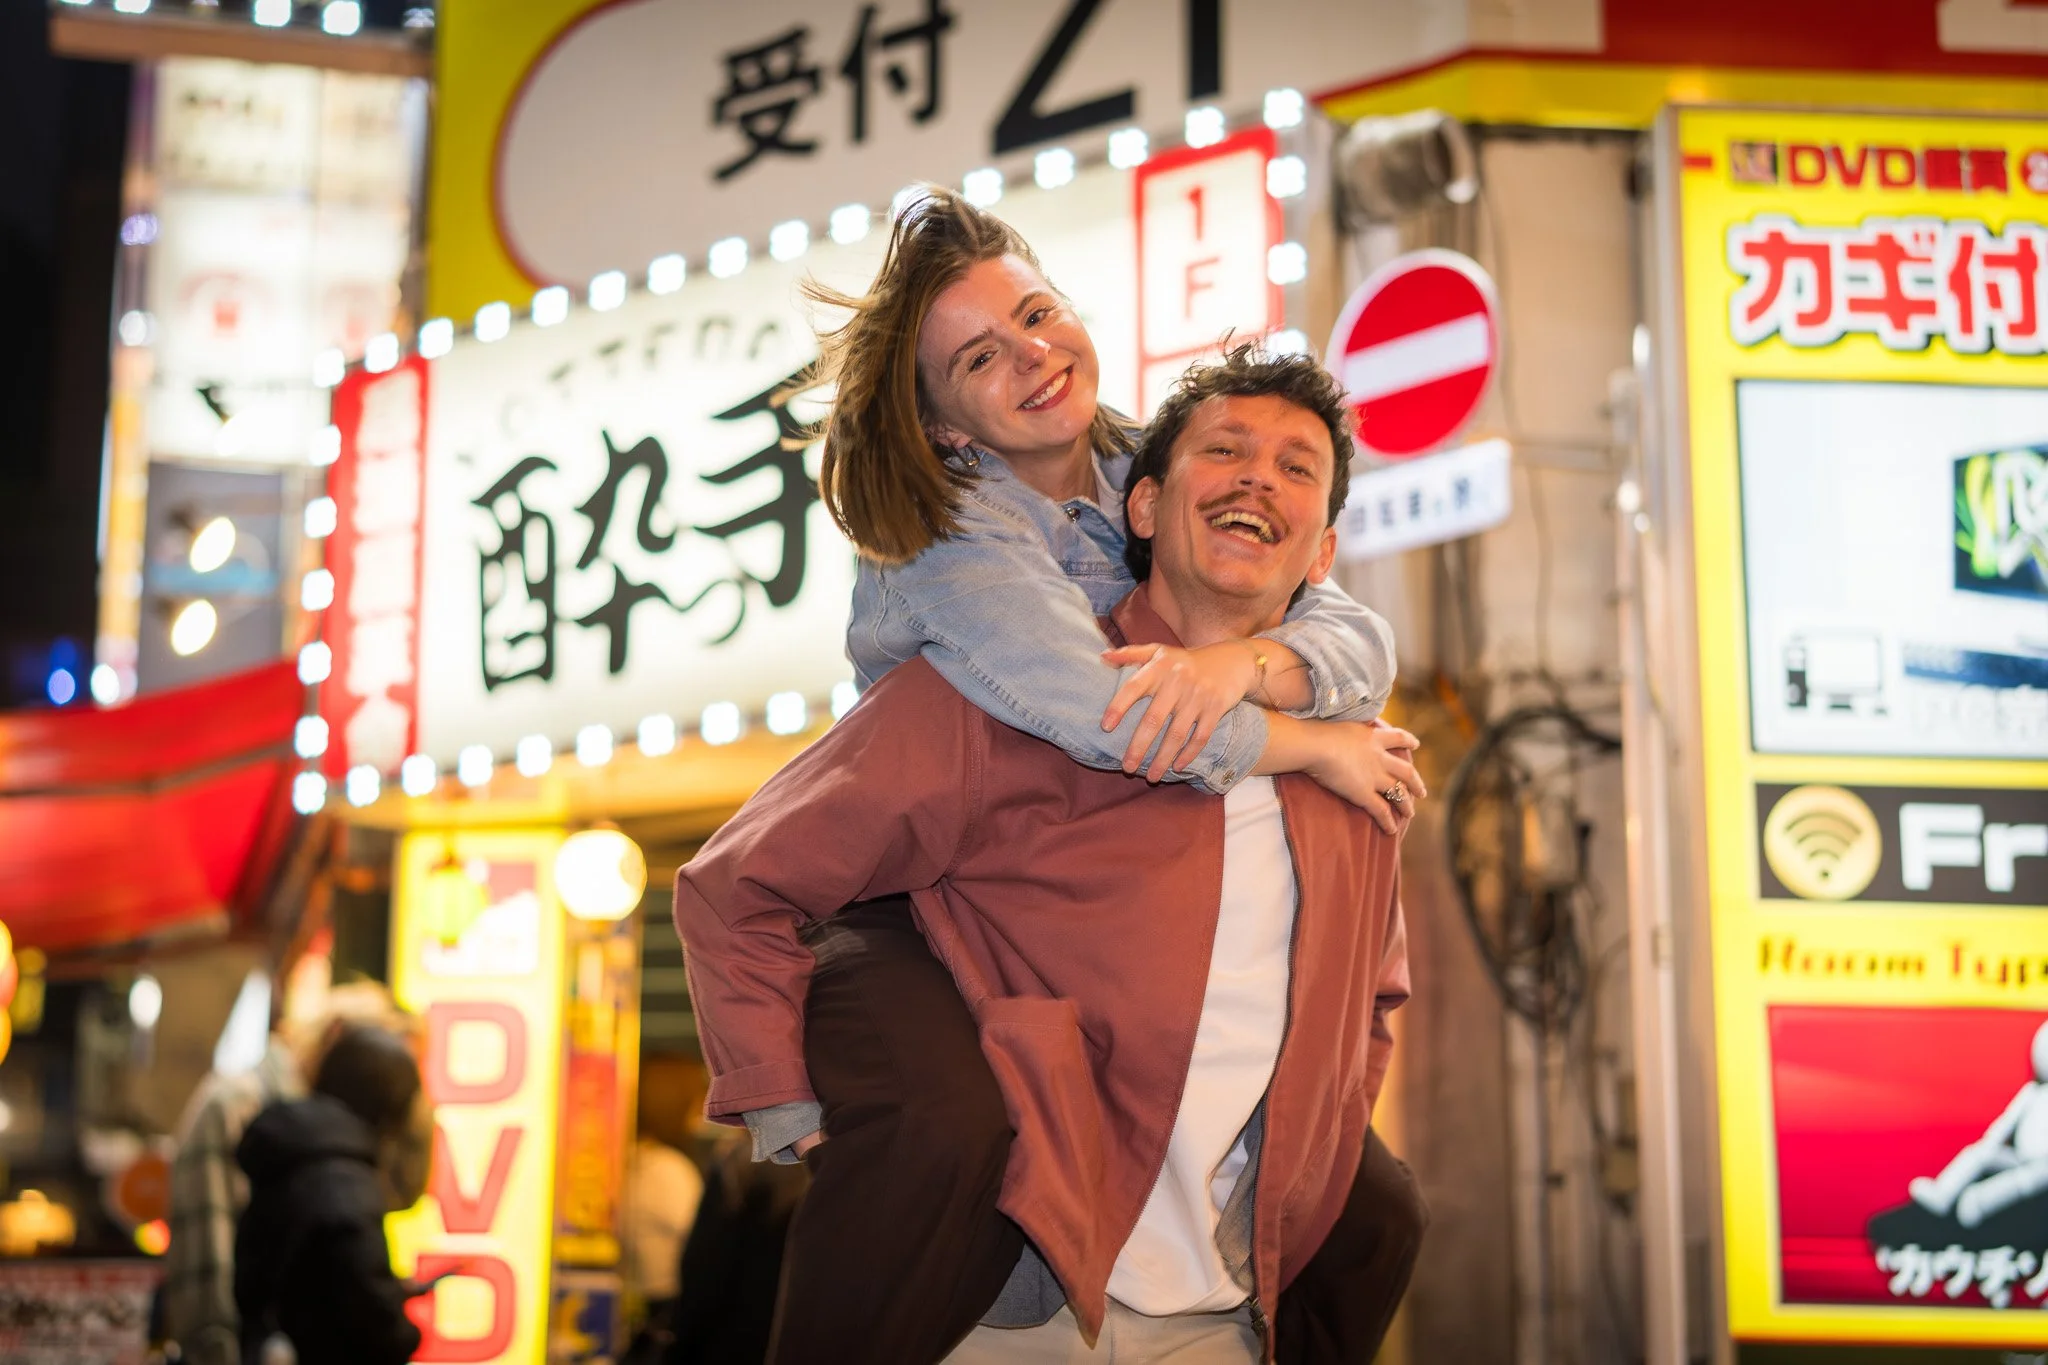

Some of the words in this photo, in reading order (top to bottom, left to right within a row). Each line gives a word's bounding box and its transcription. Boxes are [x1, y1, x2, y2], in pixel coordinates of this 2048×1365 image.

[714, 0, 955, 181] 受付
[1740, 226, 2044, 338] カギ付
